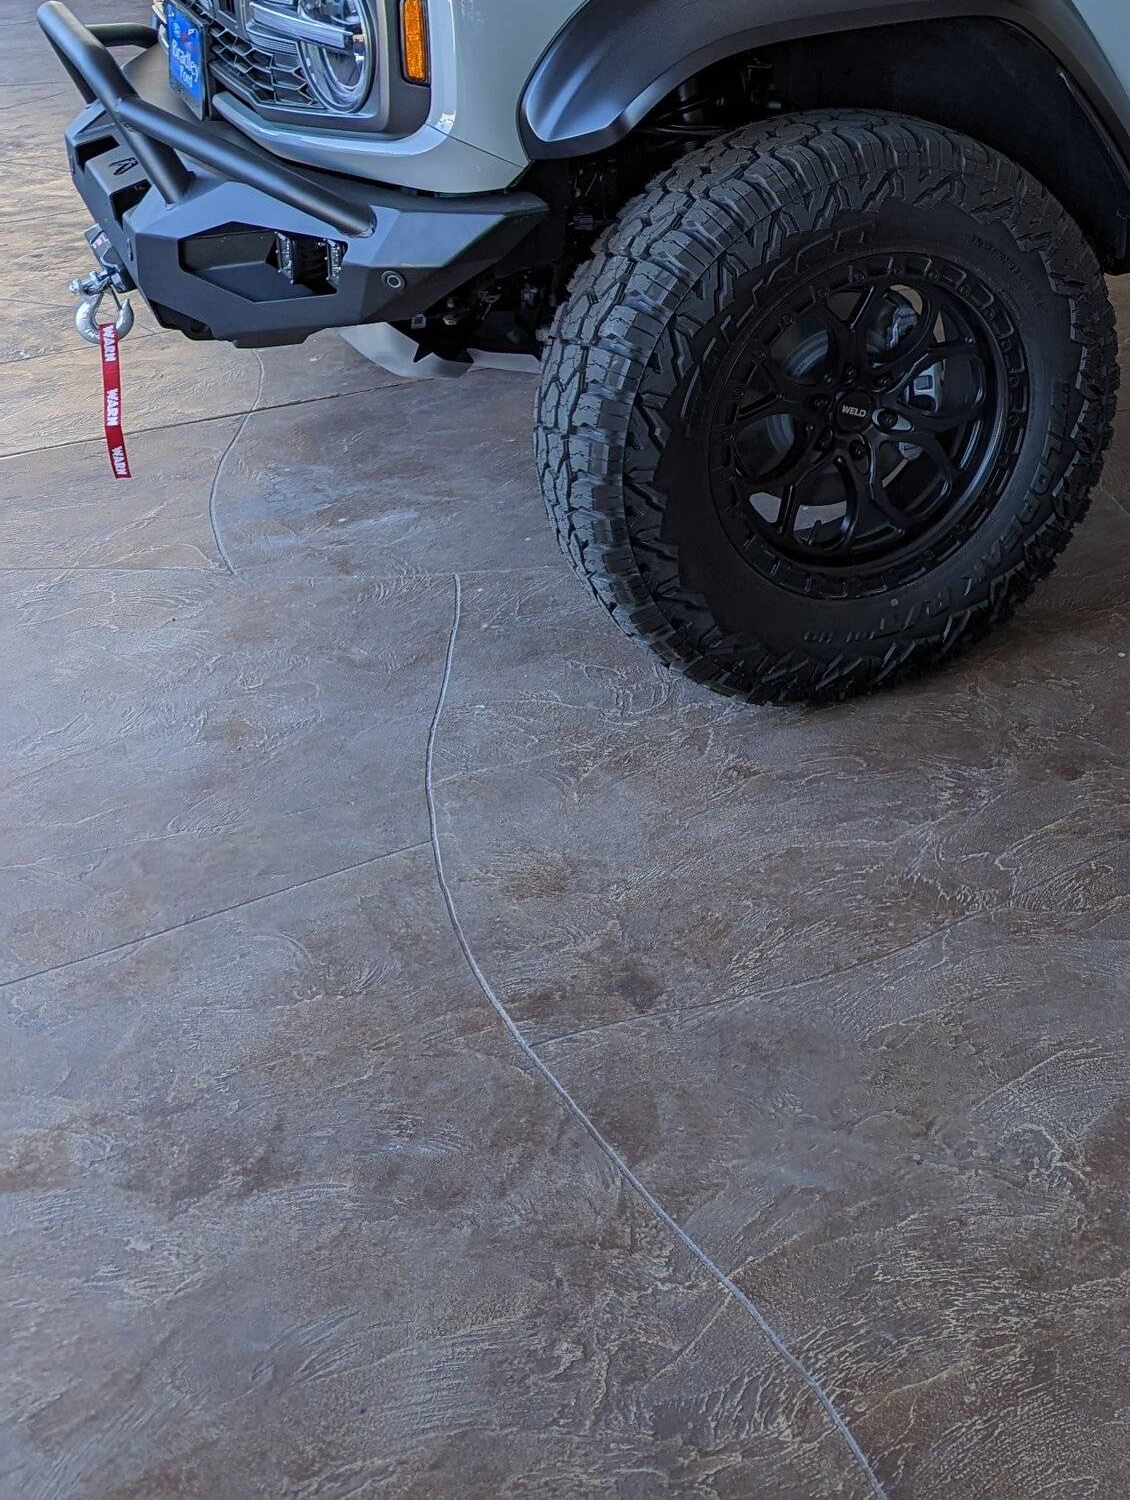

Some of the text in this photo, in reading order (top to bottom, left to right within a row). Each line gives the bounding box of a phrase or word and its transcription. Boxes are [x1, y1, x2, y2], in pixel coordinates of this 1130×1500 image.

[172, 38, 200, 83] Bradley
[103, 325, 116, 362] WARN
[106, 387, 119, 426] WARN
[842, 404, 867, 418] WELD
[112, 445, 128, 475] WARN
